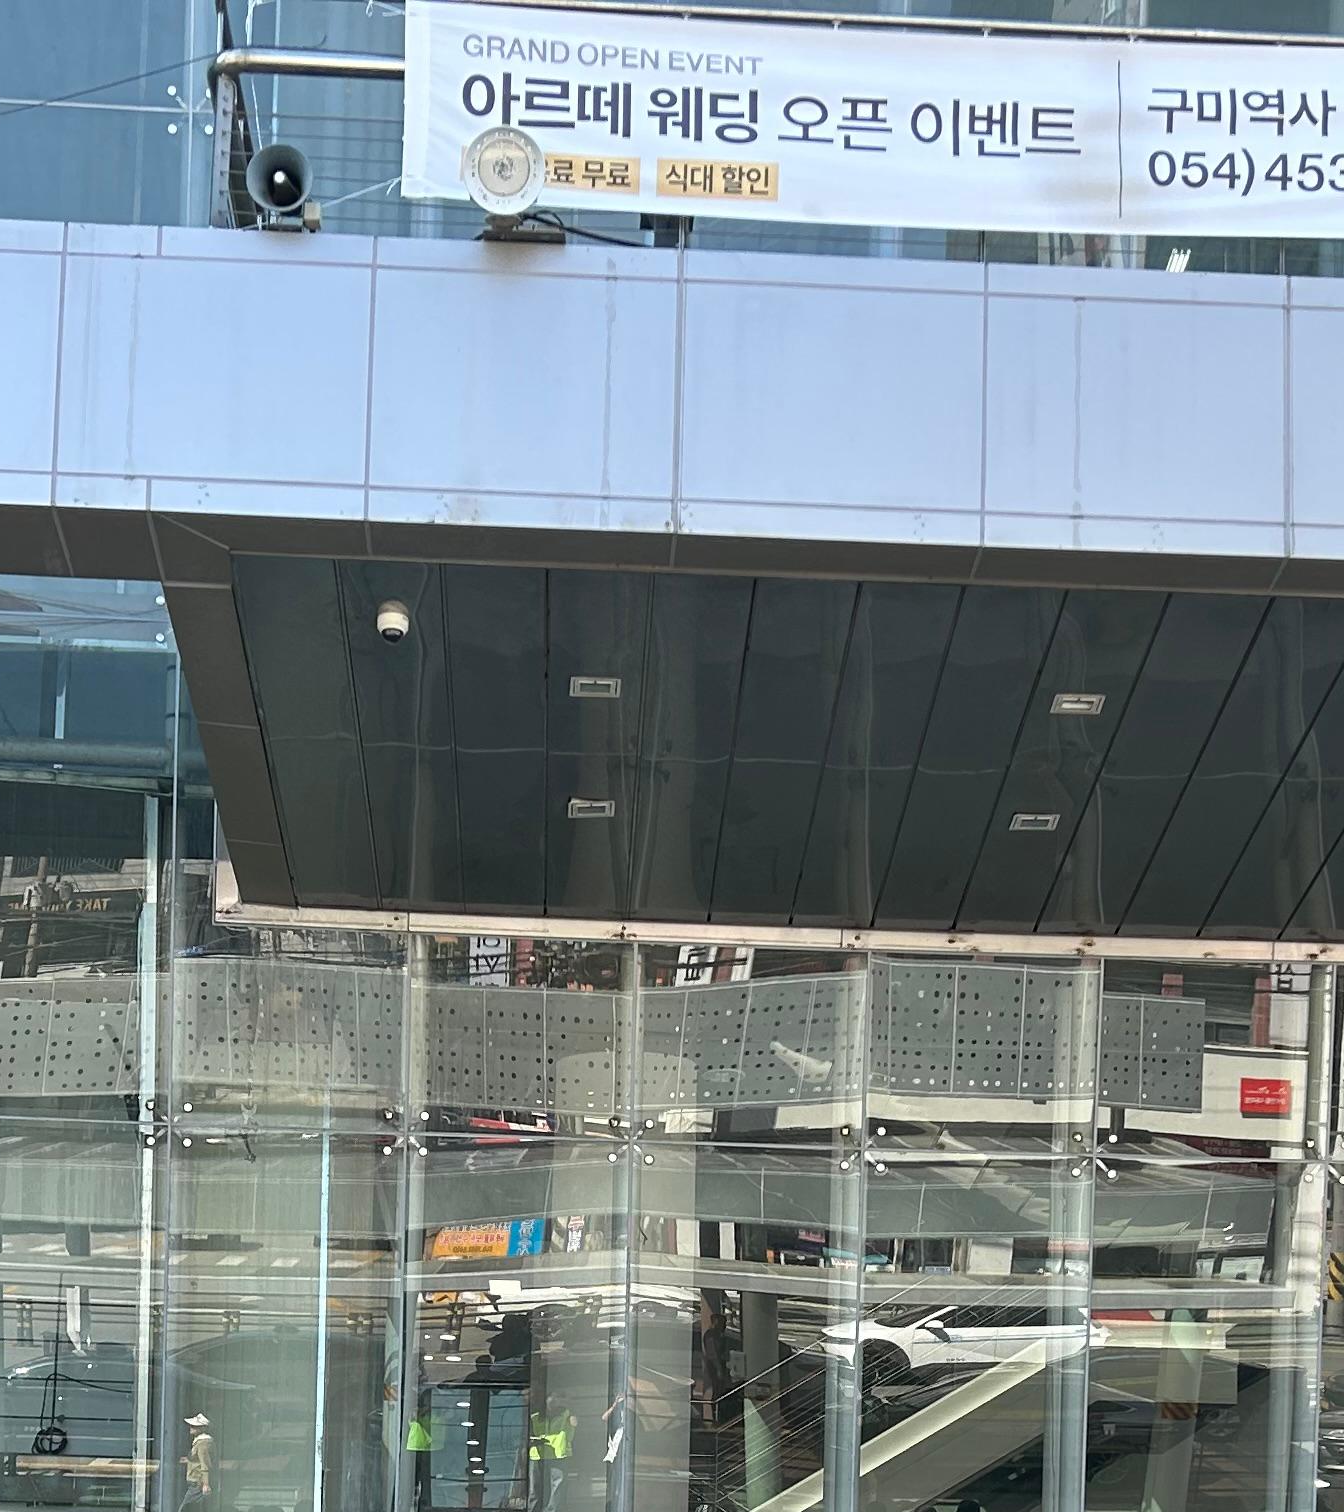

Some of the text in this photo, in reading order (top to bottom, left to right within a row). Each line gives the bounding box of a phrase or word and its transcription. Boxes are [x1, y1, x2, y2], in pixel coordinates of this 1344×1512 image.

[463, 33, 763, 76] GRAND OPEN EVENT
[462, 71, 1081, 157] 아르떼 웨딩 오픈 이벤트
[1148, 88, 1336, 136] 구미역사
[582, 160, 631, 187] 무료
[666, 163, 769, 195] 식대 할인
